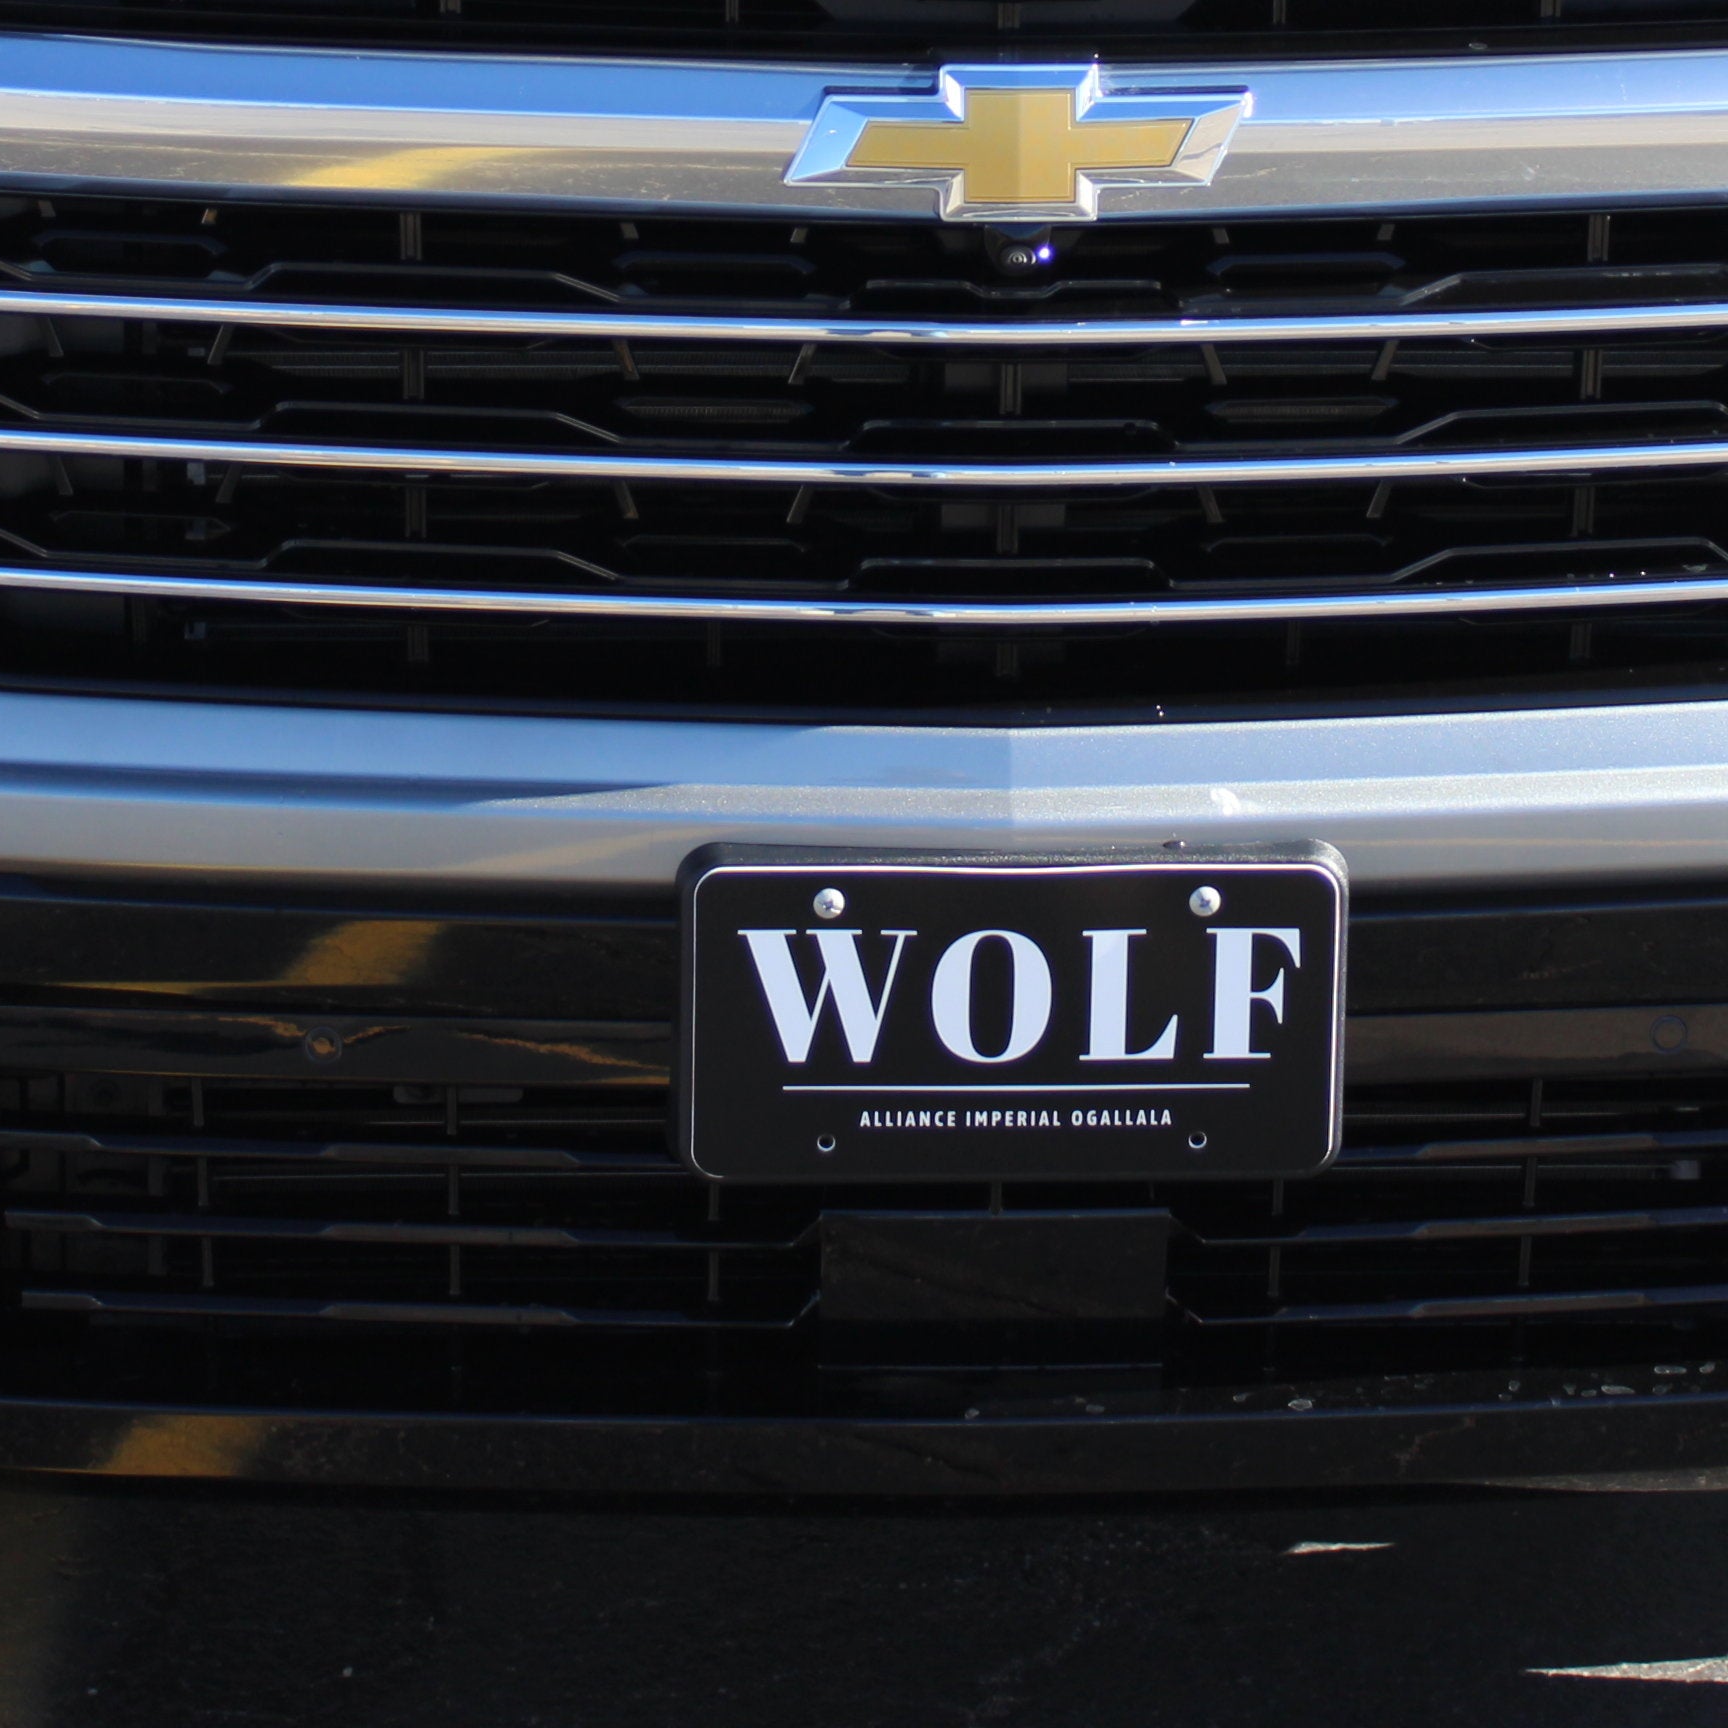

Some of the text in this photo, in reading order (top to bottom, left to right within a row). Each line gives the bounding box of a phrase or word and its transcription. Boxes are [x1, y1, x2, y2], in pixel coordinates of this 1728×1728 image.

[736, 927, 1302, 1064] WOLF
[859, 1107, 1173, 1129] ALLIANCE IMPERIAL OGALLALA
